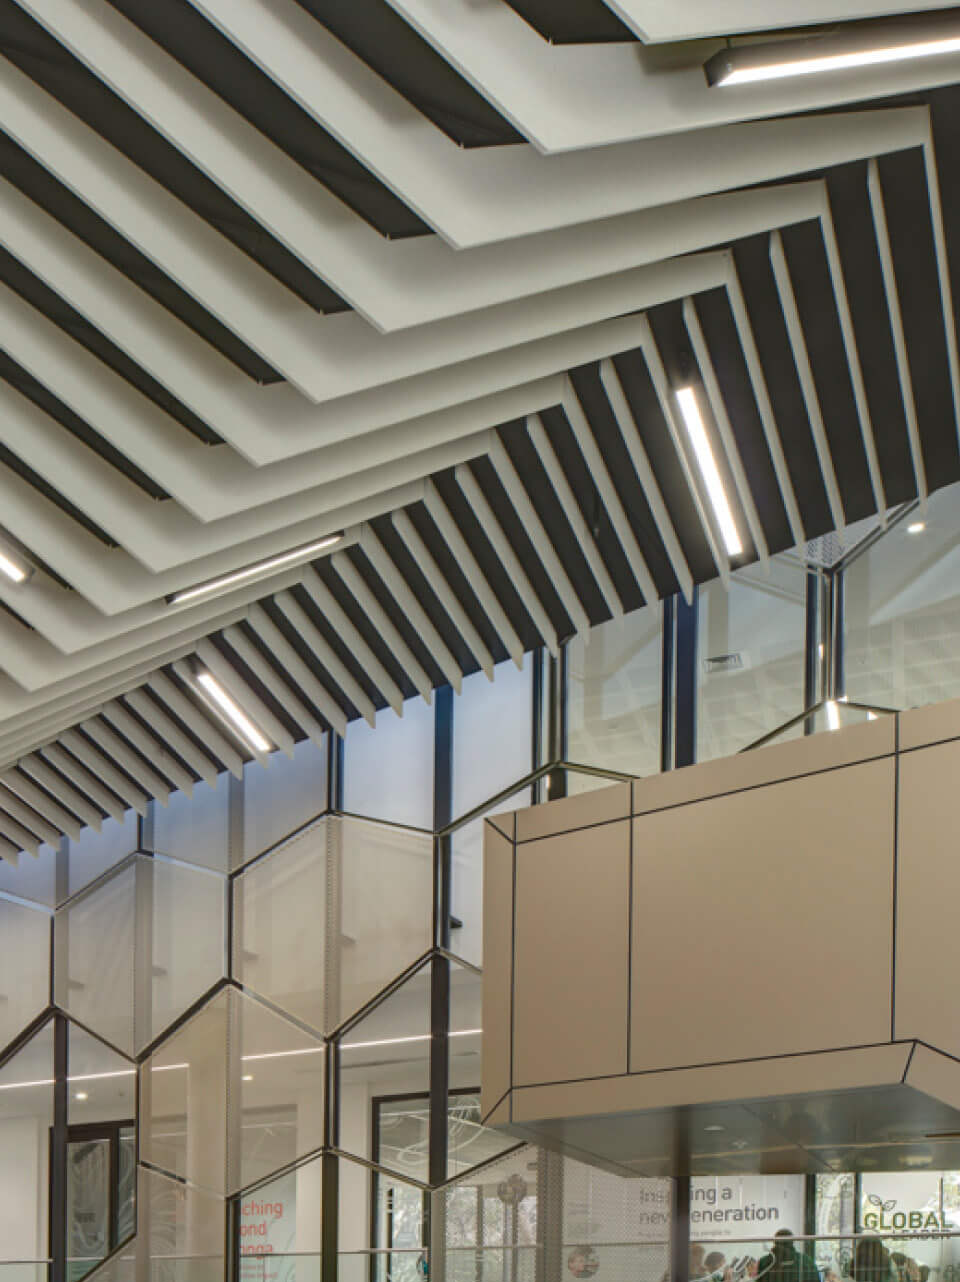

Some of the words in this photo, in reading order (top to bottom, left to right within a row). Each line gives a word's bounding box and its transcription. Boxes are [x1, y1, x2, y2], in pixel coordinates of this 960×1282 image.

[241, 1199, 283, 1219] ching
[690, 1204, 780, 1224] eneration
[864, 1211, 954, 1229] GLOBAL
